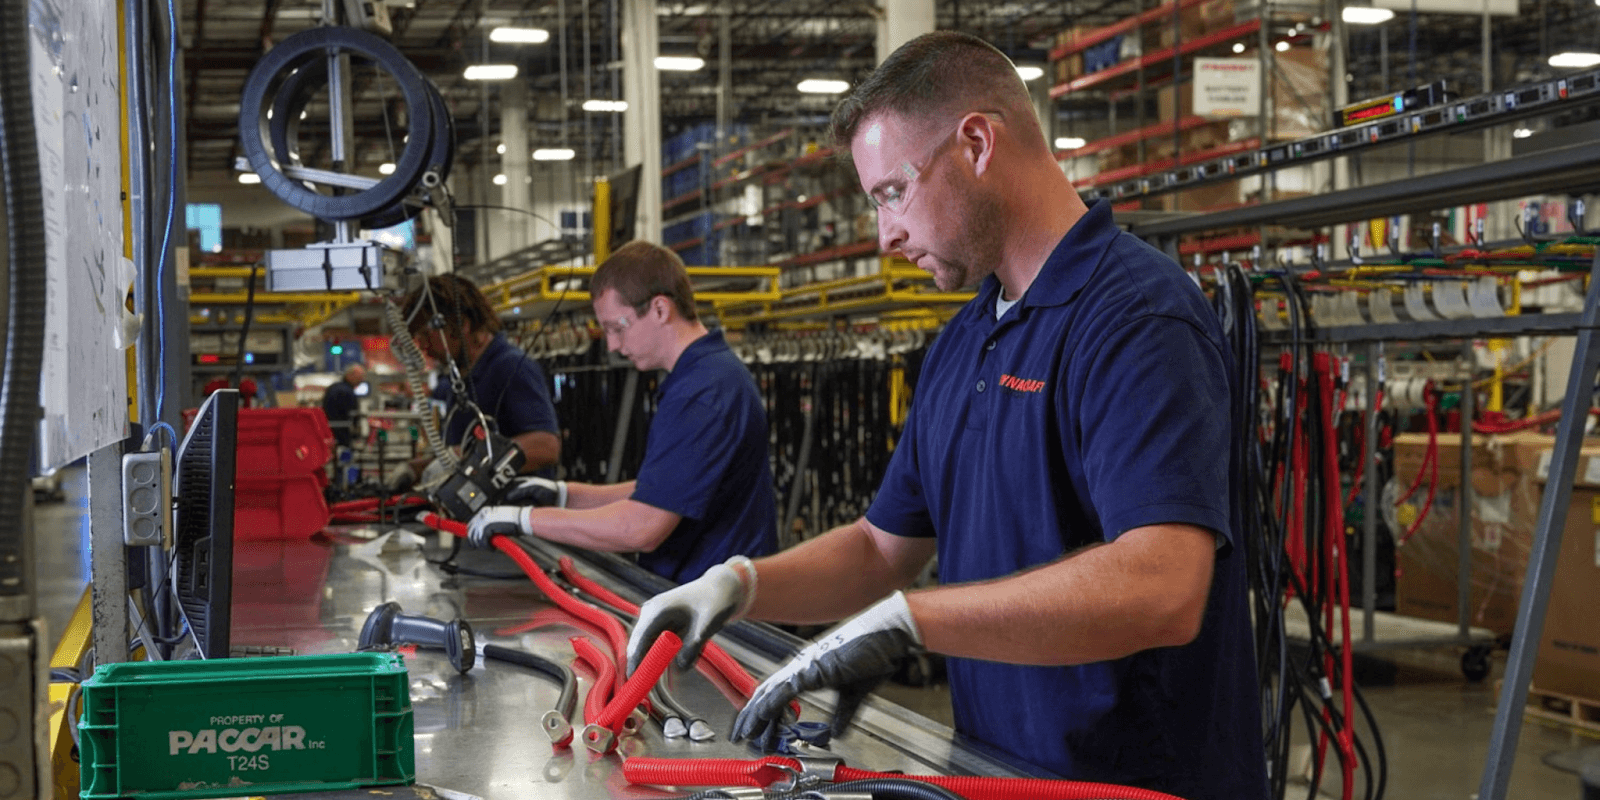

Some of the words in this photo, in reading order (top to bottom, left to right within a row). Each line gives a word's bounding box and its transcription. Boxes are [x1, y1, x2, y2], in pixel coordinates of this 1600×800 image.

[210, 714, 265, 725] PROPERTY
[269, 713, 284, 723] OF
[168, 725, 306, 755] PACCAR
[308, 740, 325, 749] Inc
[227, 754, 270, 771] T24S
